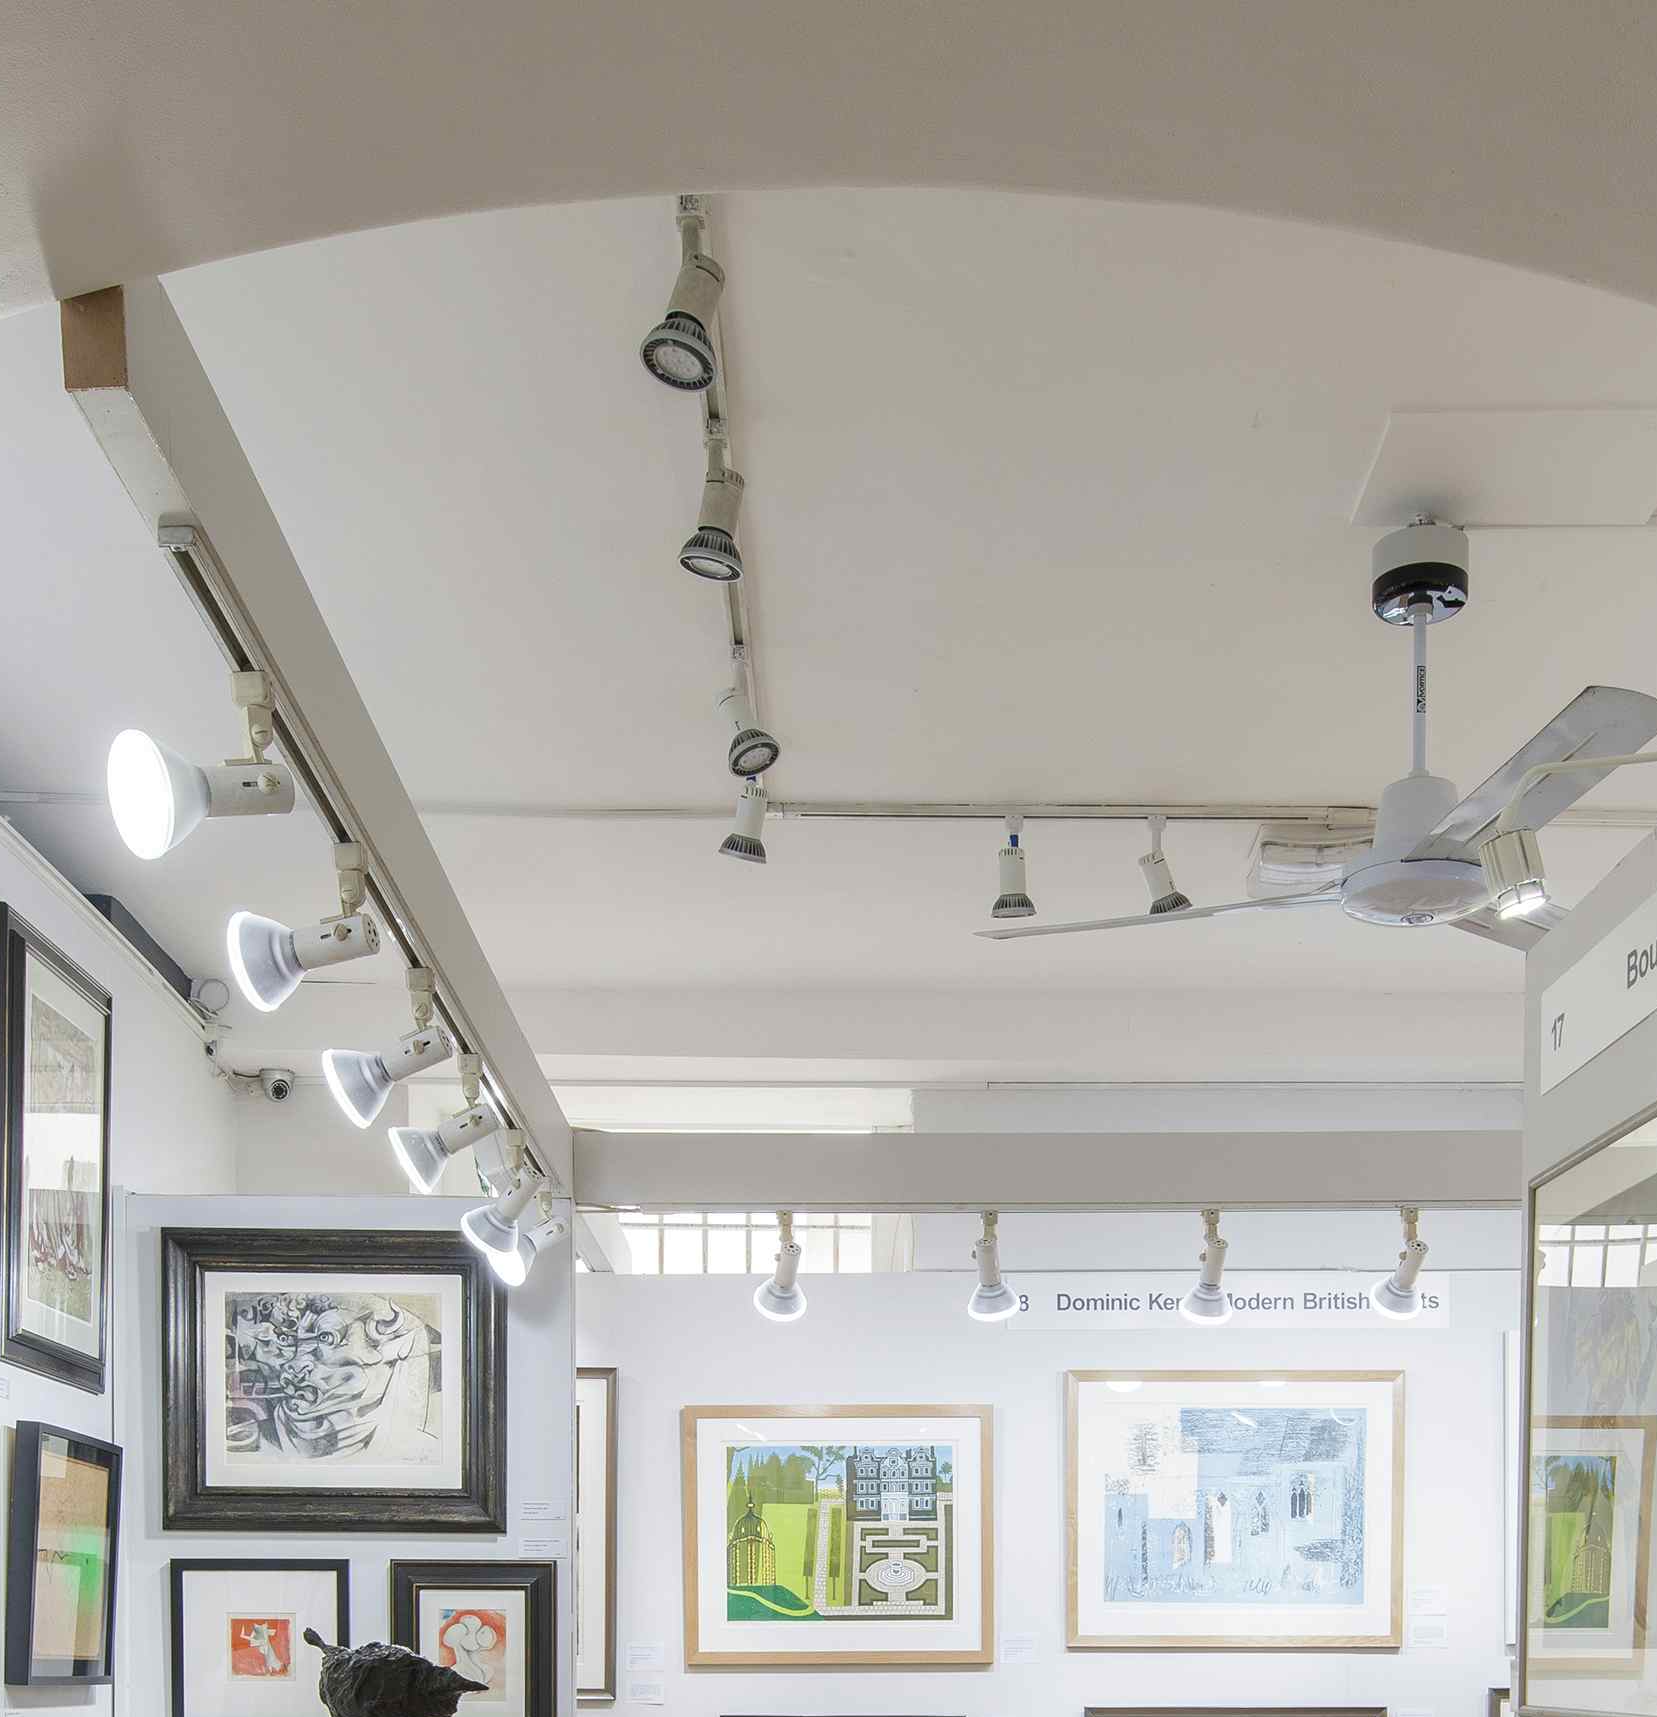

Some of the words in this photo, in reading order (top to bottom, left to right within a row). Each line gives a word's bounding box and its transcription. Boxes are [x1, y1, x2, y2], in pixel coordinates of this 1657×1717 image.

[1551, 1012, 1565, 1052] 17
[1056, 1293, 1141, 1311] Dominic
[1303, 1292, 1371, 1310] British
